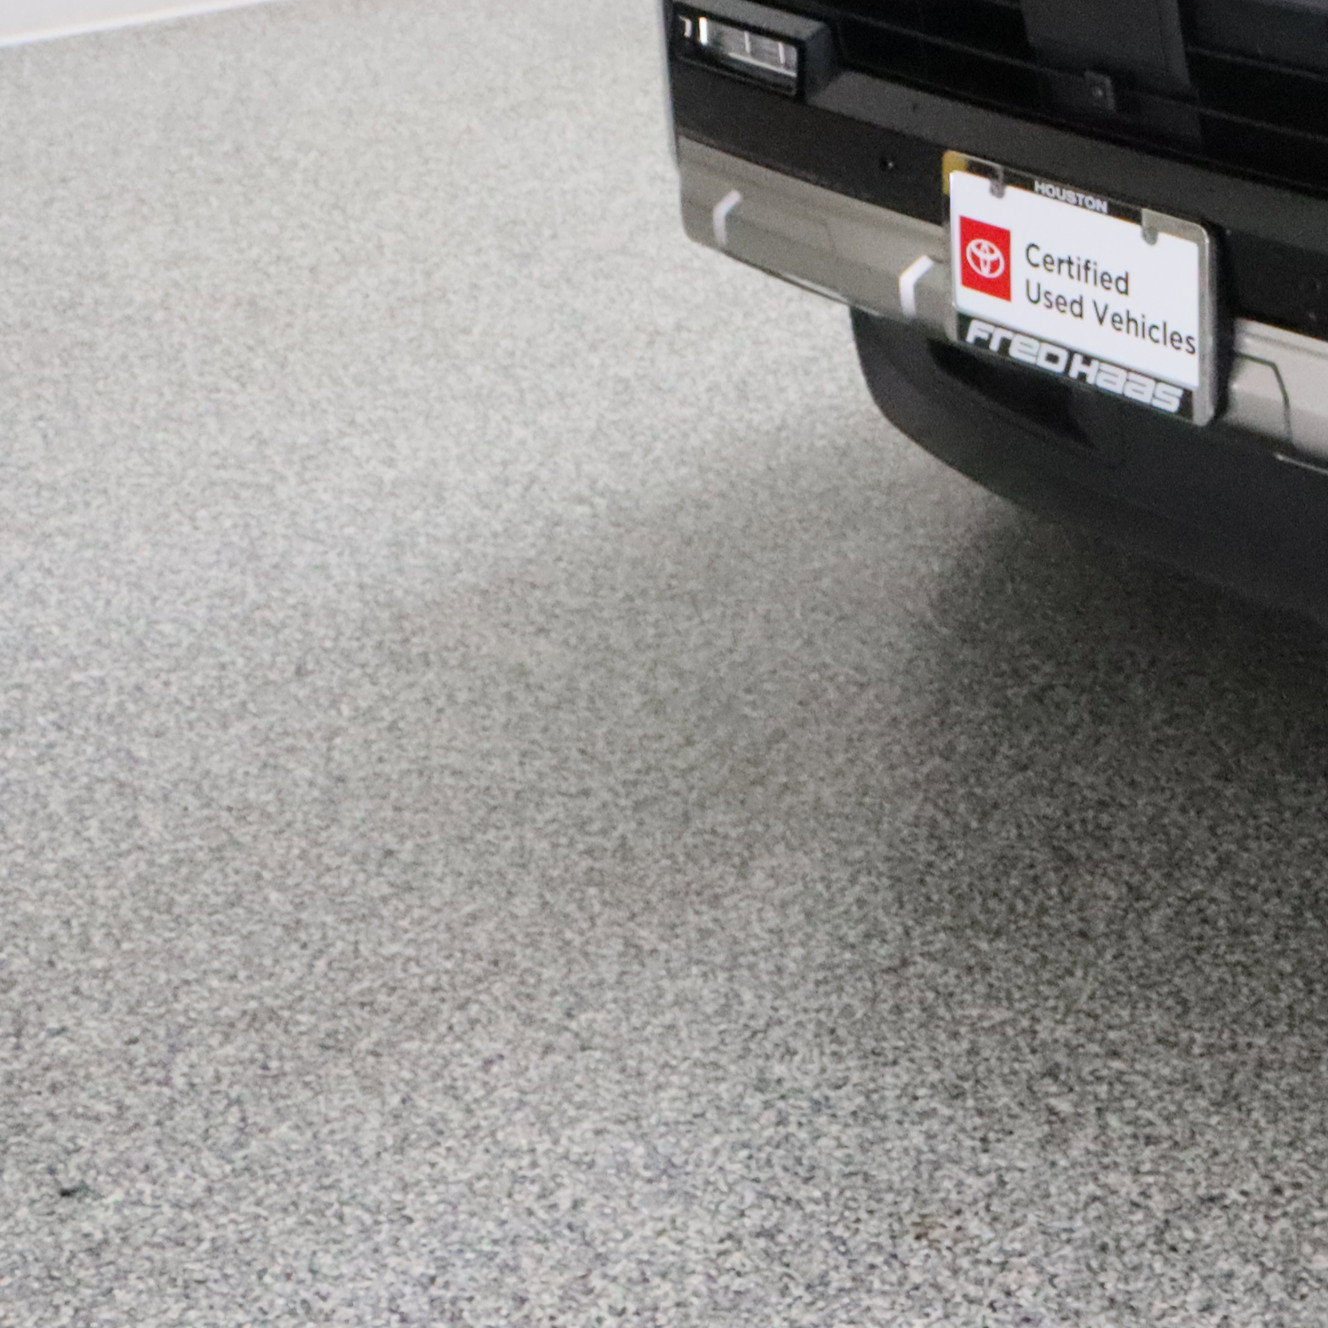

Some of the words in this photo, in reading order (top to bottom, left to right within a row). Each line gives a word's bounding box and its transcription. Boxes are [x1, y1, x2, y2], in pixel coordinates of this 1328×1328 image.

[1034, 181, 1108, 214] HOUSTON
[1026, 244, 1129, 295] Certified
[1026, 280, 1084, 319] Used
[1093, 301, 1196, 355] Vehicles
